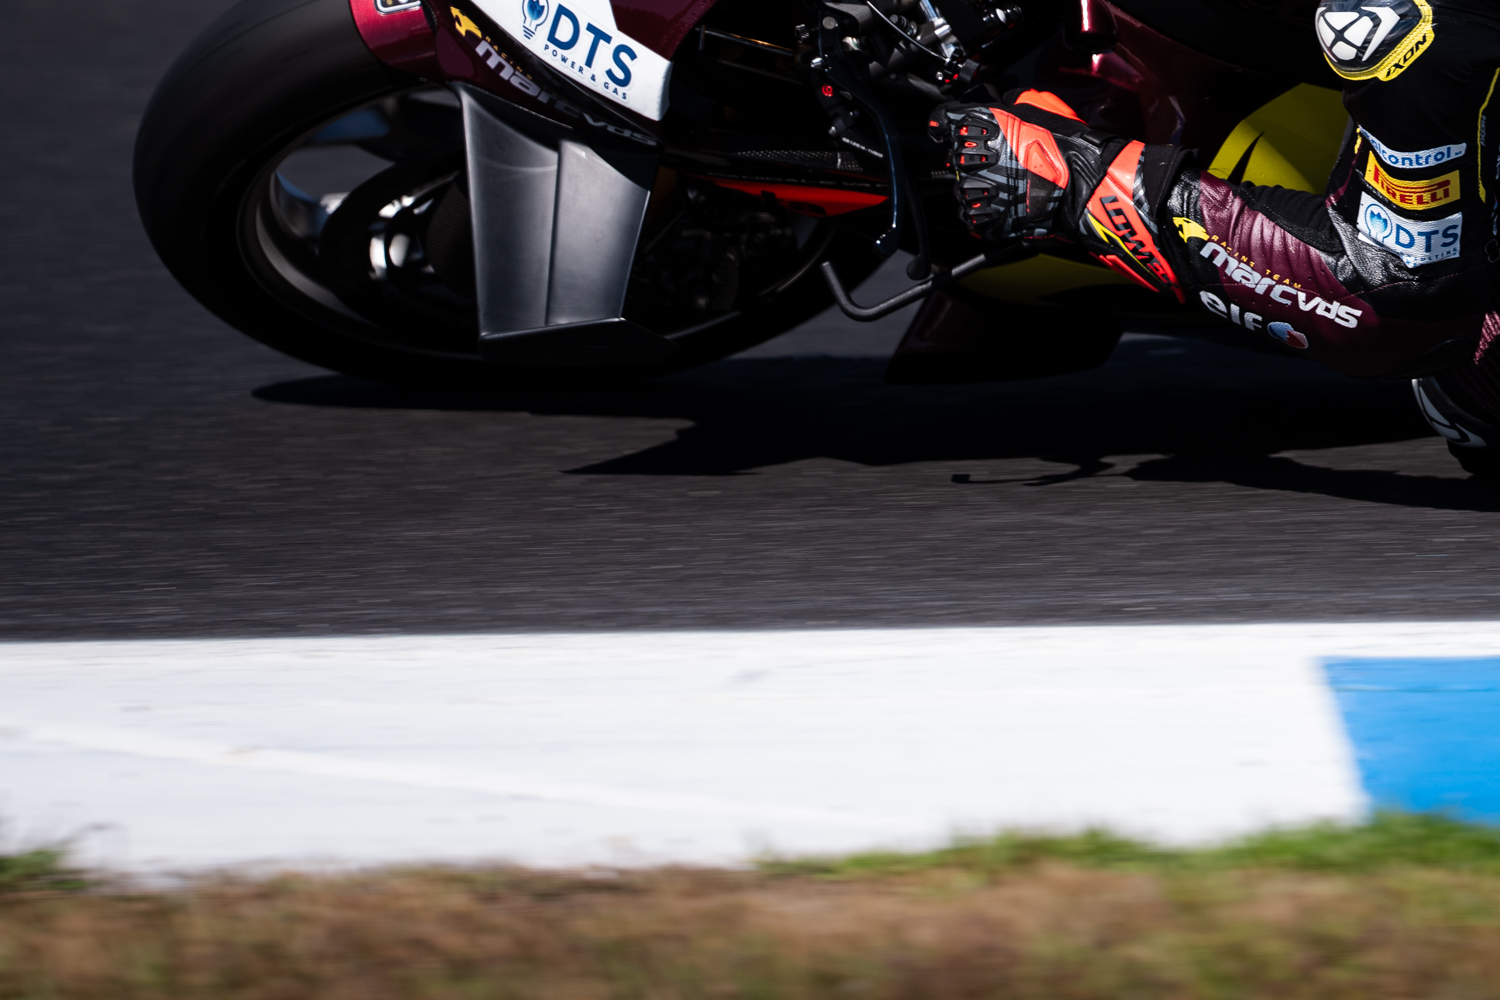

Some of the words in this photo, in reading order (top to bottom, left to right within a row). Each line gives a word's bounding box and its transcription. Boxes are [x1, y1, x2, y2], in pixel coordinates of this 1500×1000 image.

[547, 3, 638, 88] DTS
[543, 43, 584, 76] POWER
[590, 73, 597, 83] &
[603, 81, 628, 101] GAS
[1373, 163, 1452, 206] PIRELLI
[1395, 223, 1460, 253] DTS
[1265, 268, 1302, 290] TEAM
[1199, 290, 1263, 332] elf
